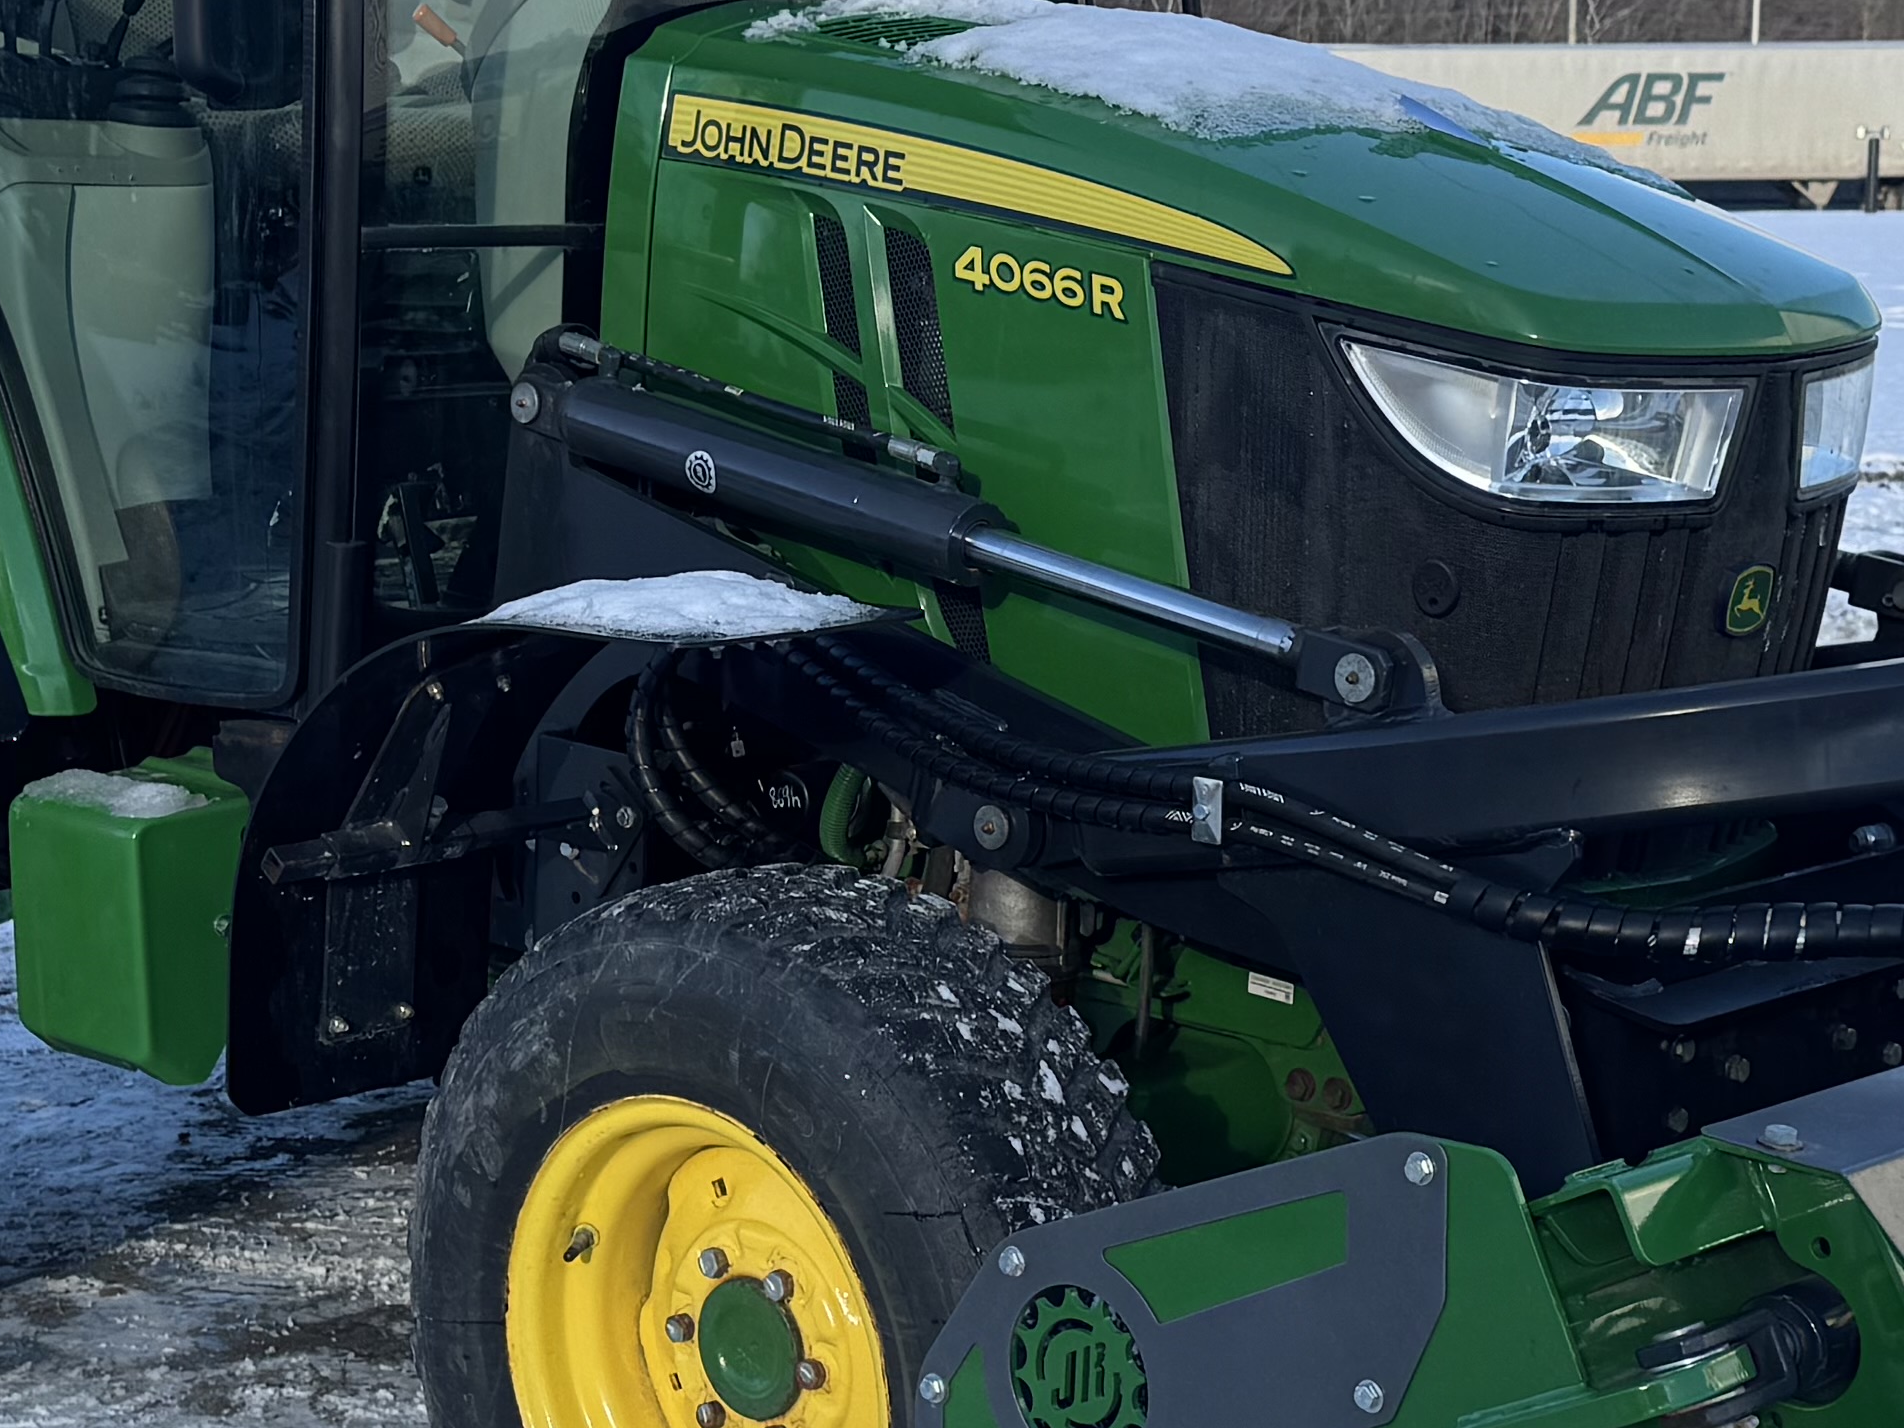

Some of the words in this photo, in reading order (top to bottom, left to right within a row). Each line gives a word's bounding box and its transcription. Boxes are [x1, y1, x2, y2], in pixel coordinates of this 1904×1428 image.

[1576, 72, 1726, 126] ABF
[680, 109, 772, 162] JOHN
[777, 123, 906, 186] DEERE
[1646, 131, 1708, 148] Freight
[955, 246, 1126, 321] 4066R
